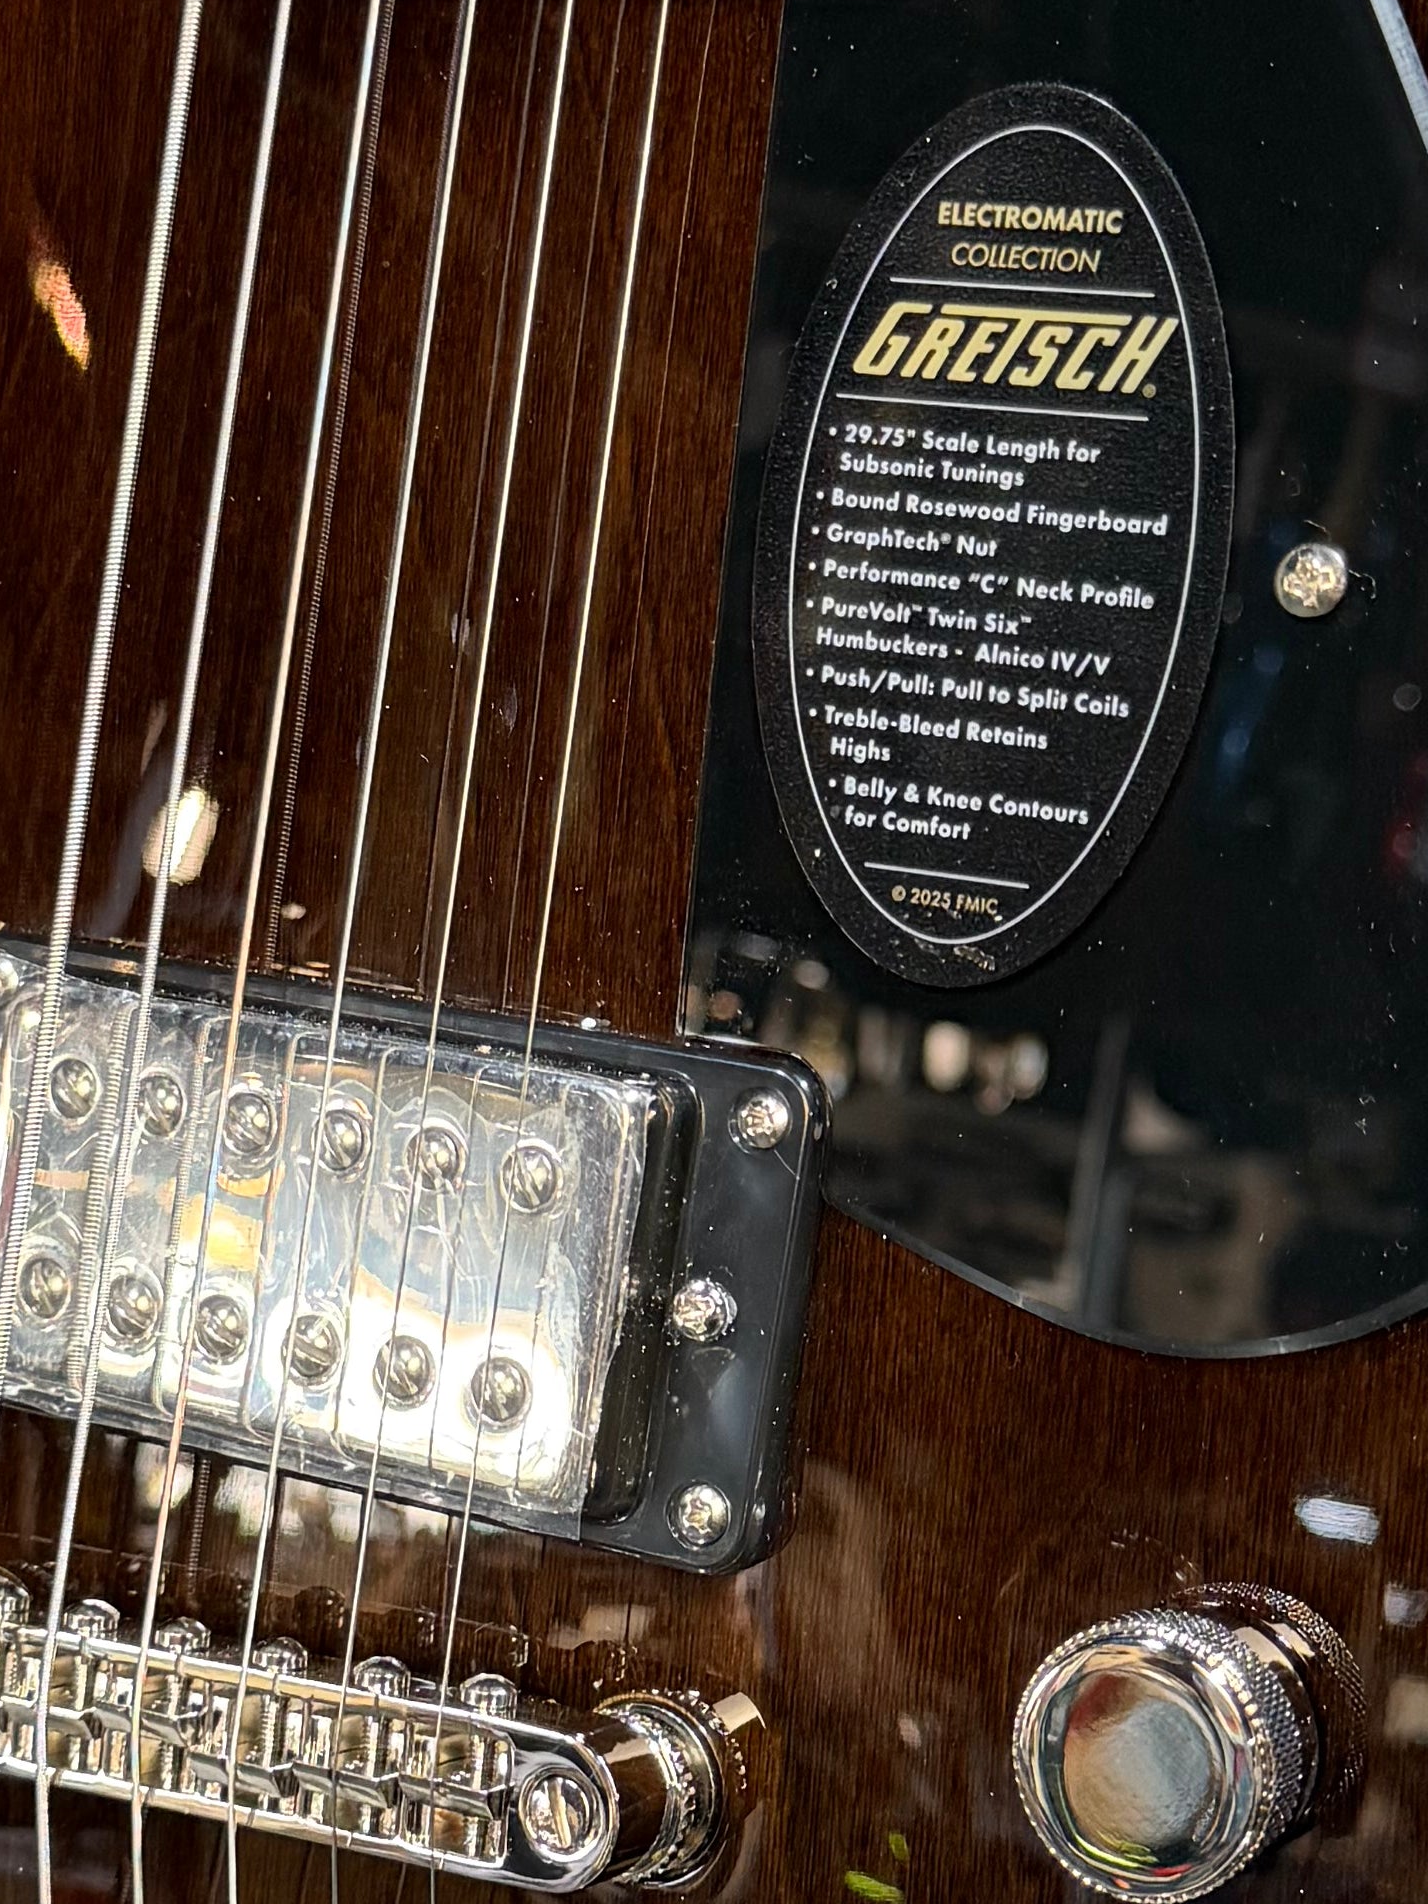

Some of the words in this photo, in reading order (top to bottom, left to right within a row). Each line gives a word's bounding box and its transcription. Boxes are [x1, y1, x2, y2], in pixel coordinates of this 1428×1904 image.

[938, 200, 1123, 234] ELECTROMATIC
[951, 242, 1101, 273] COLLECTION
[844, 424, 916, 447] 29.75"
[922, 430, 979, 454] Scale
[986, 436, 1060, 463] Length
[1067, 440, 1101, 463] for
[839, 452, 934, 478] Subsonic
[941, 460, 1024, 491] Tunings
[831, 487, 899, 512] Bound
[906, 495, 1020, 523] Rosewood
[1027, 504, 1168, 536] Fingerboard
[956, 535, 997, 557] Nut
[823, 558, 960, 590] Performance
[1017, 577, 1073, 602] Neck
[1081, 583, 1154, 610] Profile
[927, 607, 977, 631] Twin
[816, 626, 948, 658] Humbuckers
[975, 643, 1045, 669] Alnico
[1052, 651, 1110, 677] IV/V
[821, 665, 934, 695] Push/Pull:
[942, 678, 982, 702] Pull
[989, 686, 1010, 705] to
[1018, 687, 1068, 712] Split
[1074, 693, 1129, 718] Coils
[824, 705, 960, 739] Treble-Bleed
[966, 721, 1047, 750] Retains
[830, 736, 890, 764] Highs
[844, 776, 897, 805] Belly
[904, 783, 919, 803] &
[927, 785, 982, 811] Knee
[989, 794, 1089, 825] Contours
[844, 805, 876, 828] for
[882, 810, 971, 840] Comfort
[910, 887, 951, 910] 2025
[956, 894, 999, 916] FMIC
